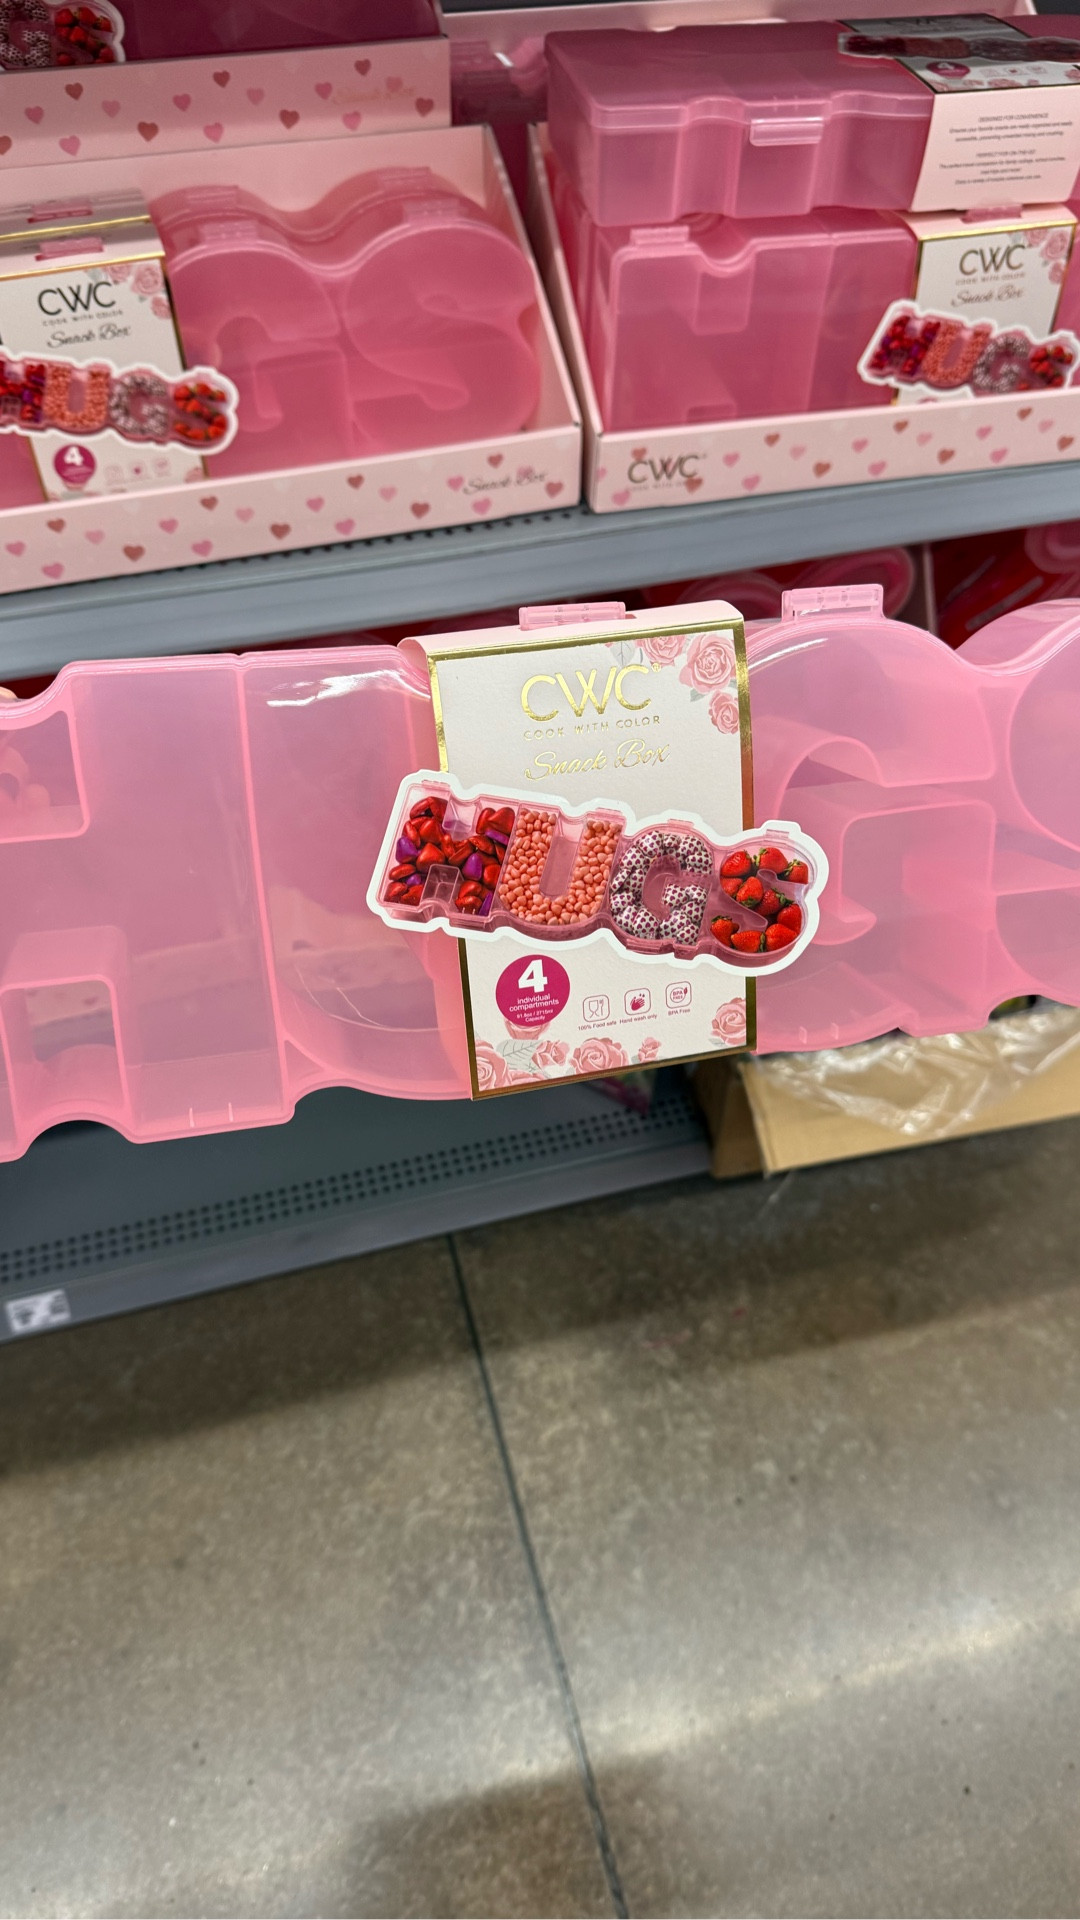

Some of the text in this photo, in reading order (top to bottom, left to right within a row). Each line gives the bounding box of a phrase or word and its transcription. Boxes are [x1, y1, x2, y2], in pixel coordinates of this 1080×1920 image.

[950, 284, 1024, 308] Snack Box
[47, 322, 132, 349] Snack Box
[63, 446, 84, 467] 4
[523, 715, 661, 741] COOK WITH COLOR
[524, 738, 671, 781] Snack Box
[518, 959, 548, 993] 4
[509, 999, 560, 1012] compartments
[517, 993, 551, 1004] individual
[525, 1015, 546, 1023] Capacity
[578, 1019, 617, 1031] 100% Food safe
[619, 1013, 658, 1024] Hand wash only
